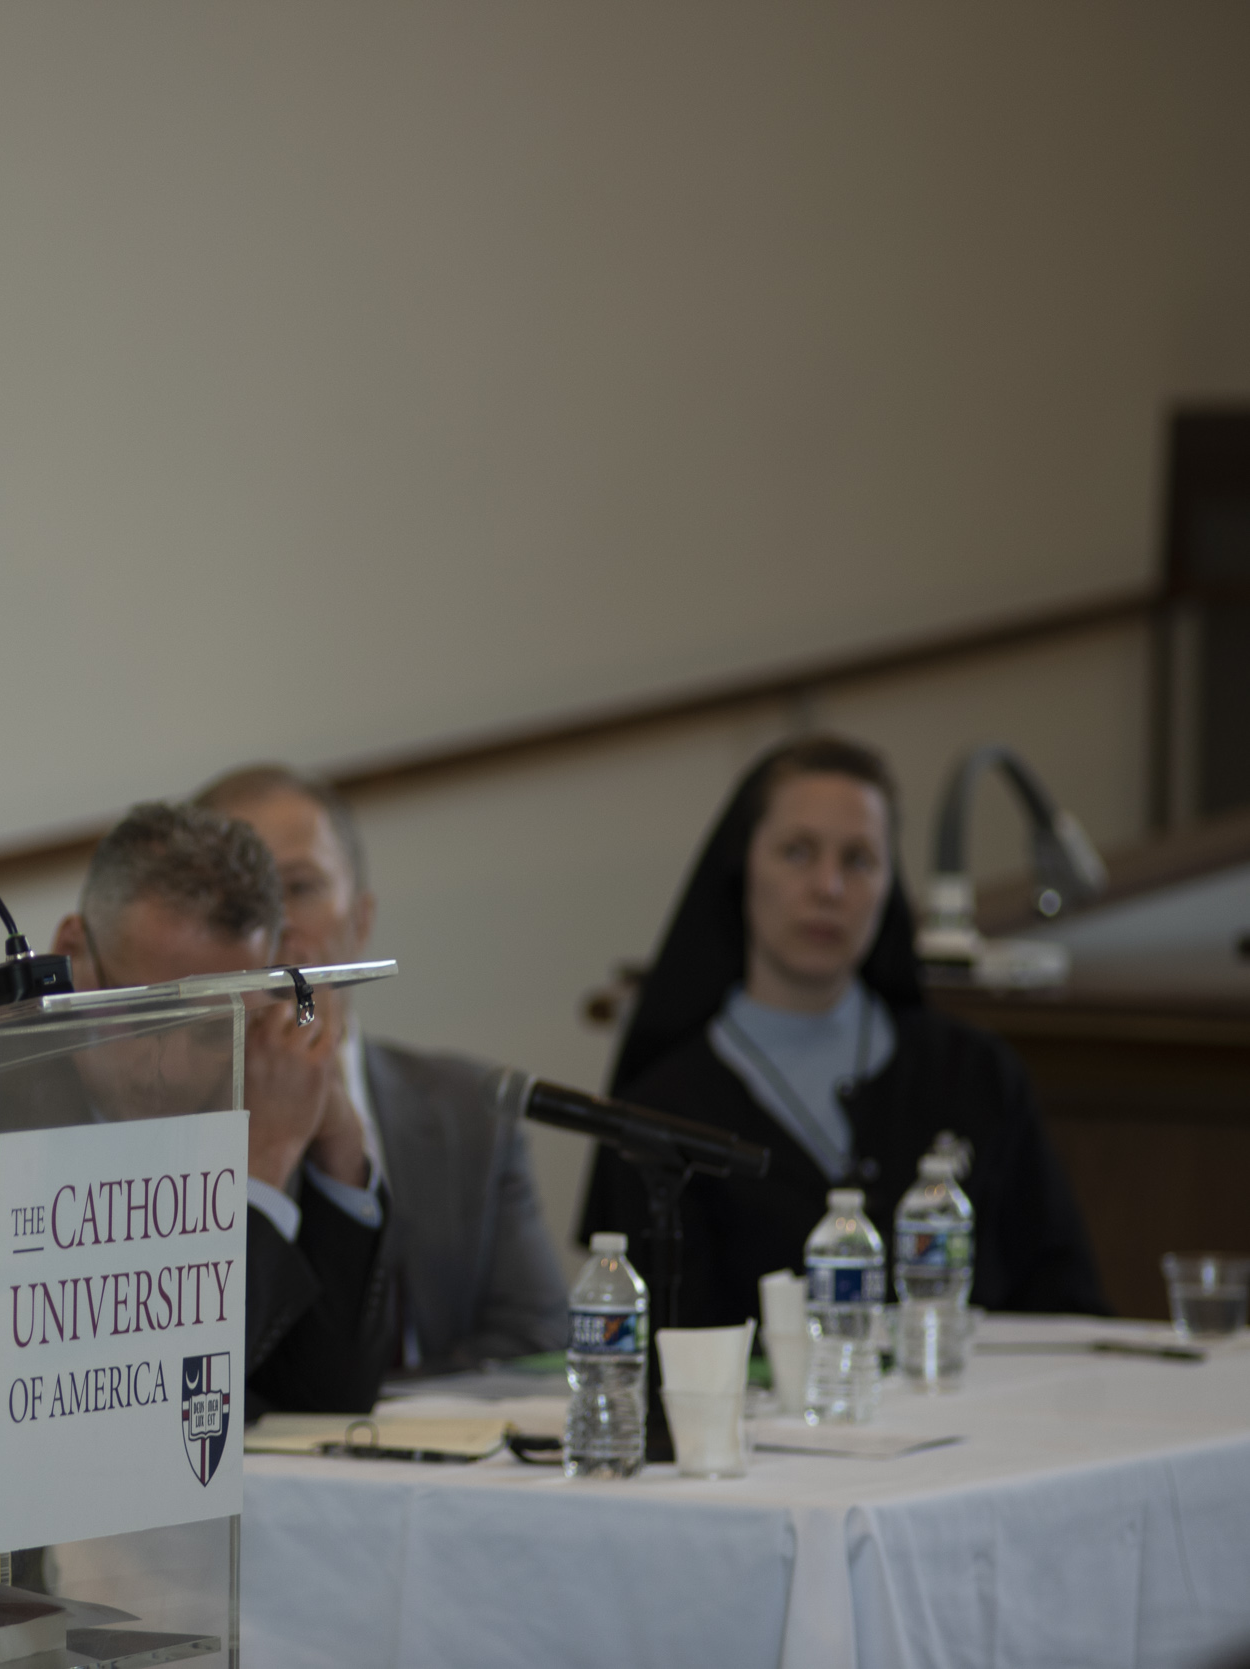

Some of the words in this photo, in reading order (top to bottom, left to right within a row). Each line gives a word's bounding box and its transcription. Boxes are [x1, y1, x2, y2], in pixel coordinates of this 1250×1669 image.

[11, 1206, 45, 1237] THE
[51, 1168, 235, 1249] CATHOLIC
[10, 1260, 234, 1348] UNIVERSITY
[9, 1376, 44, 1423] OF
[49, 1360, 169, 1419] AMERICA
[193, 1401, 205, 1415] DEUS
[208, 1399, 218, 1413] MEA
[196, 1414, 204, 1428] LUX
[208, 1413, 216, 1426] EST
